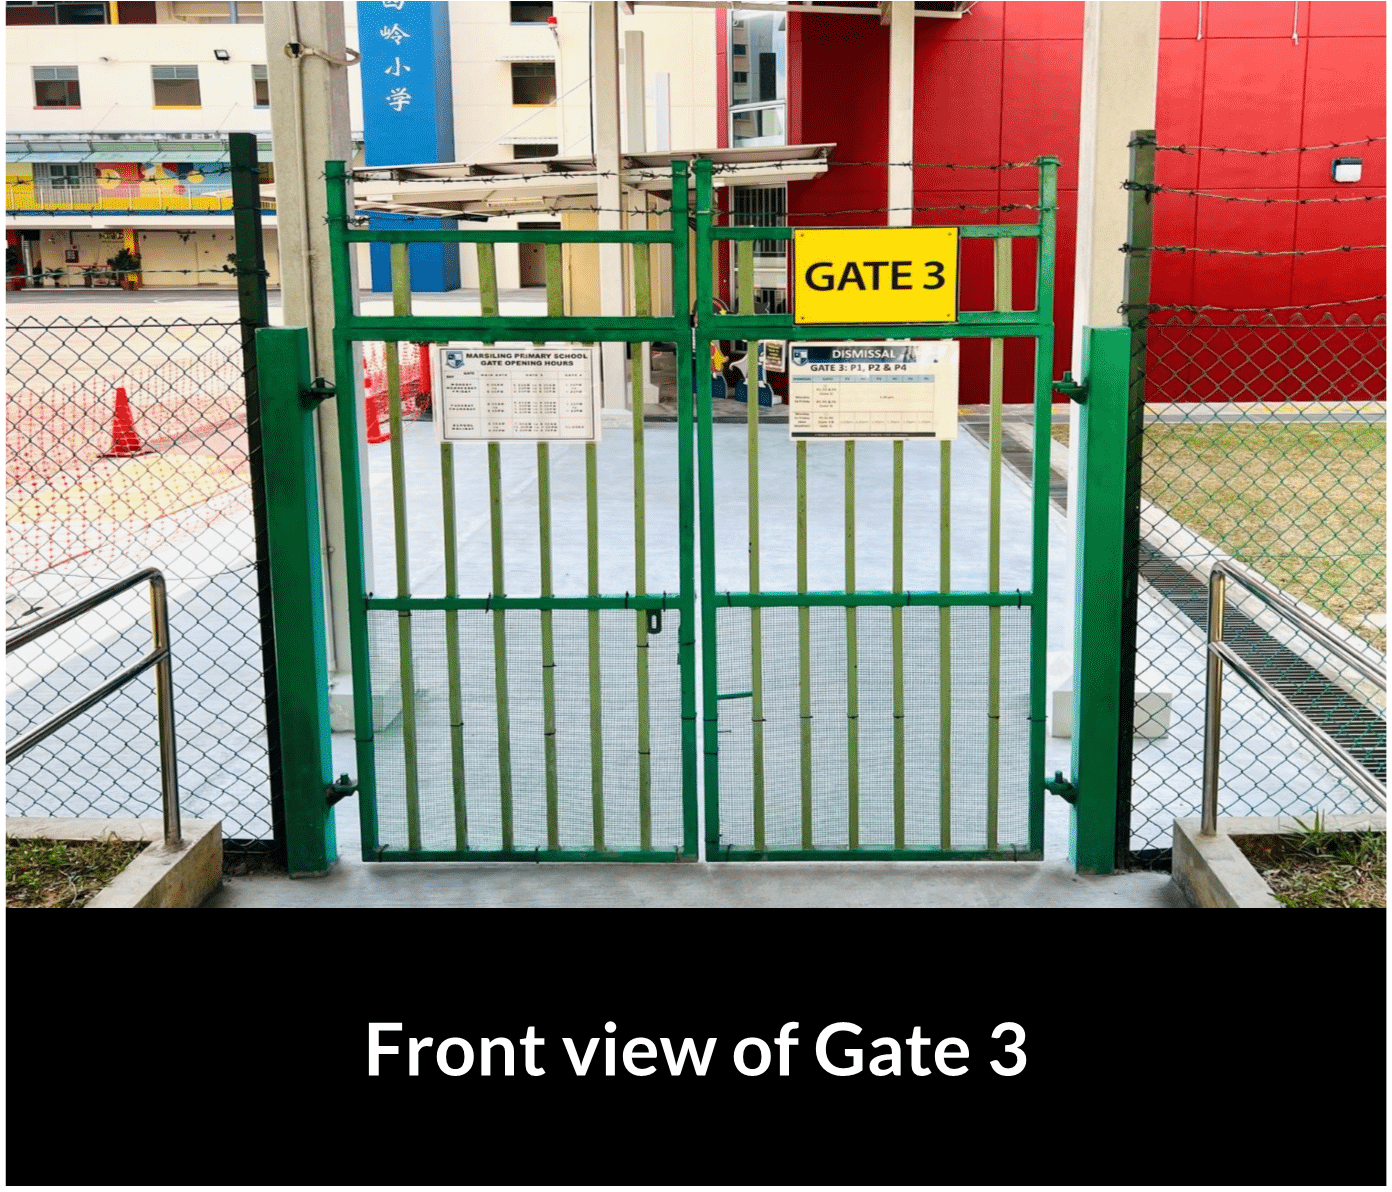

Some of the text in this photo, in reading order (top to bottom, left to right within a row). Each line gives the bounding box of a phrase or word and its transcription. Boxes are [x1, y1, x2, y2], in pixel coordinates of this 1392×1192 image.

[805, 261, 945, 291] GATE 3
[832, 350, 897, 359] DISMISSAL
